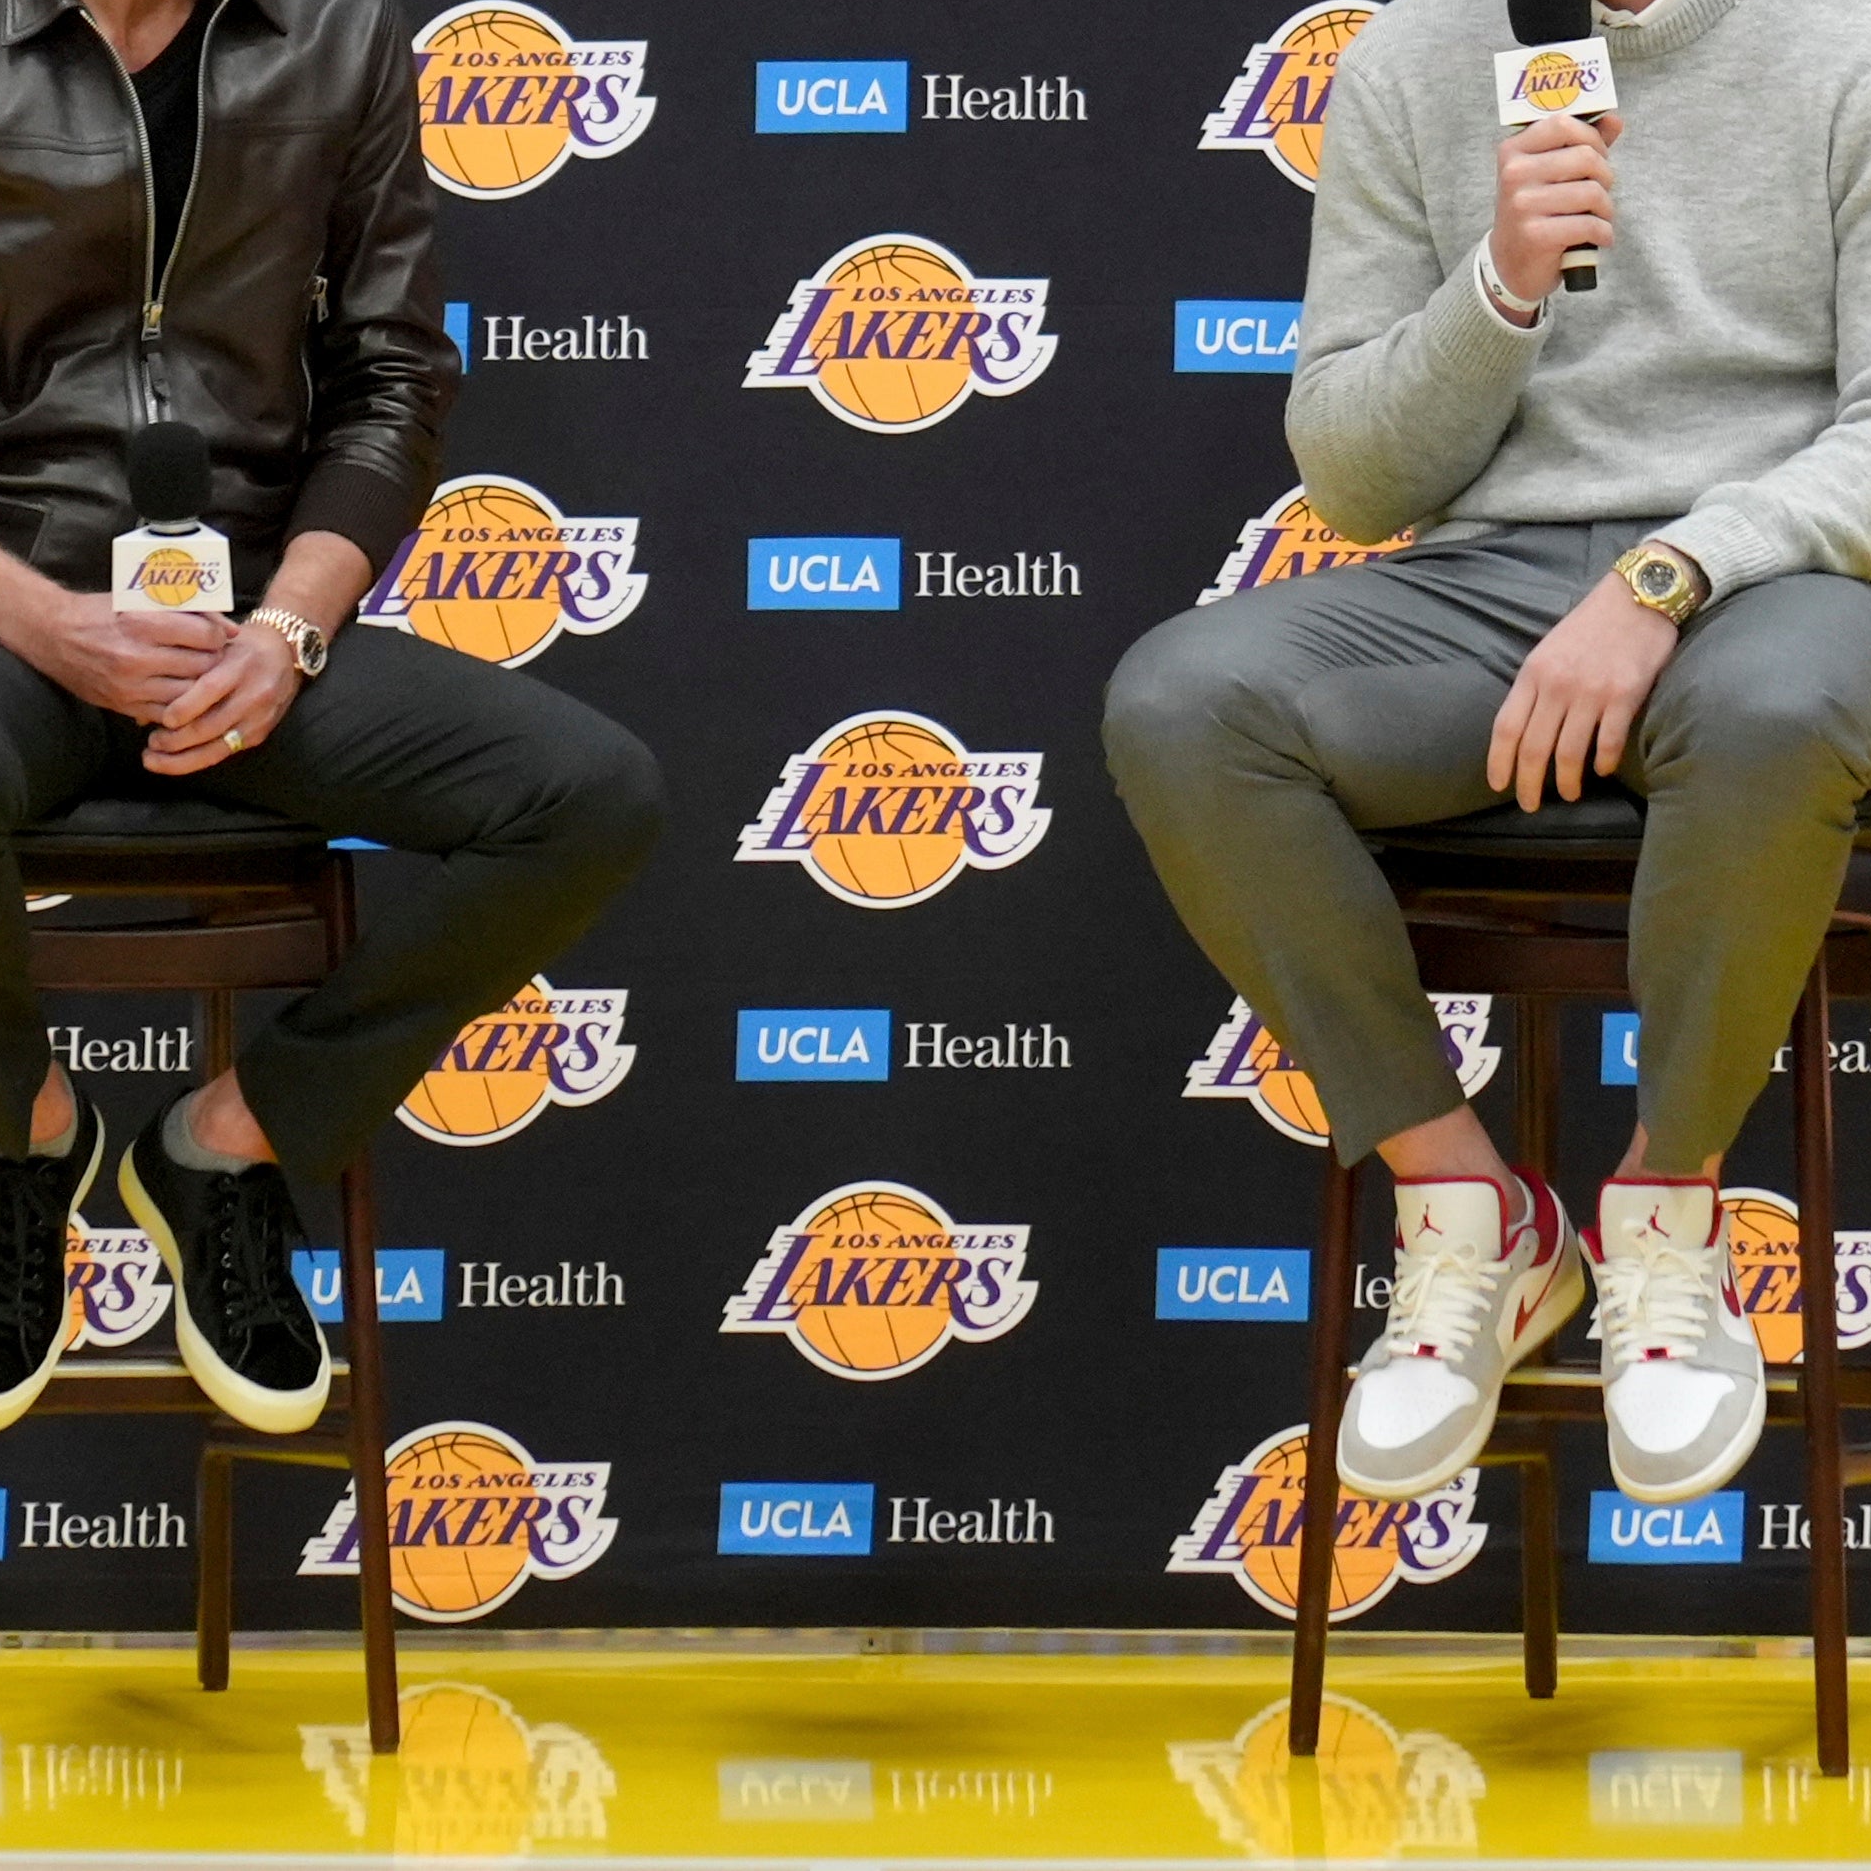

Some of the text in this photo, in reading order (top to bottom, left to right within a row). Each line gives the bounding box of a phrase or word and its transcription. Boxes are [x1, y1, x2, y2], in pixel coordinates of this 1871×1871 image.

[777, 75, 1088, 120] UCLA Health
[1510, 68, 1602, 101] LAKERS
[484, 317, 649, 361] Health
[767, 286, 1037, 383] LAKERS
[128, 561, 222, 593] LAKERS
[769, 552, 1082, 596] UCLA Health
[759, 762, 1031, 857] LAKERS
[758, 1024, 1072, 1067] UCLA Health
[830, 1232, 1017, 1251] LOS ANGELES
[461, 1263, 625, 1307] Health
[744, 1233, 1018, 1330] LAKERS
[20, 1502, 189, 1548] Health
[740, 1498, 1057, 1543] UCLA Health
[1610, 1510, 1724, 1547] UCLA
